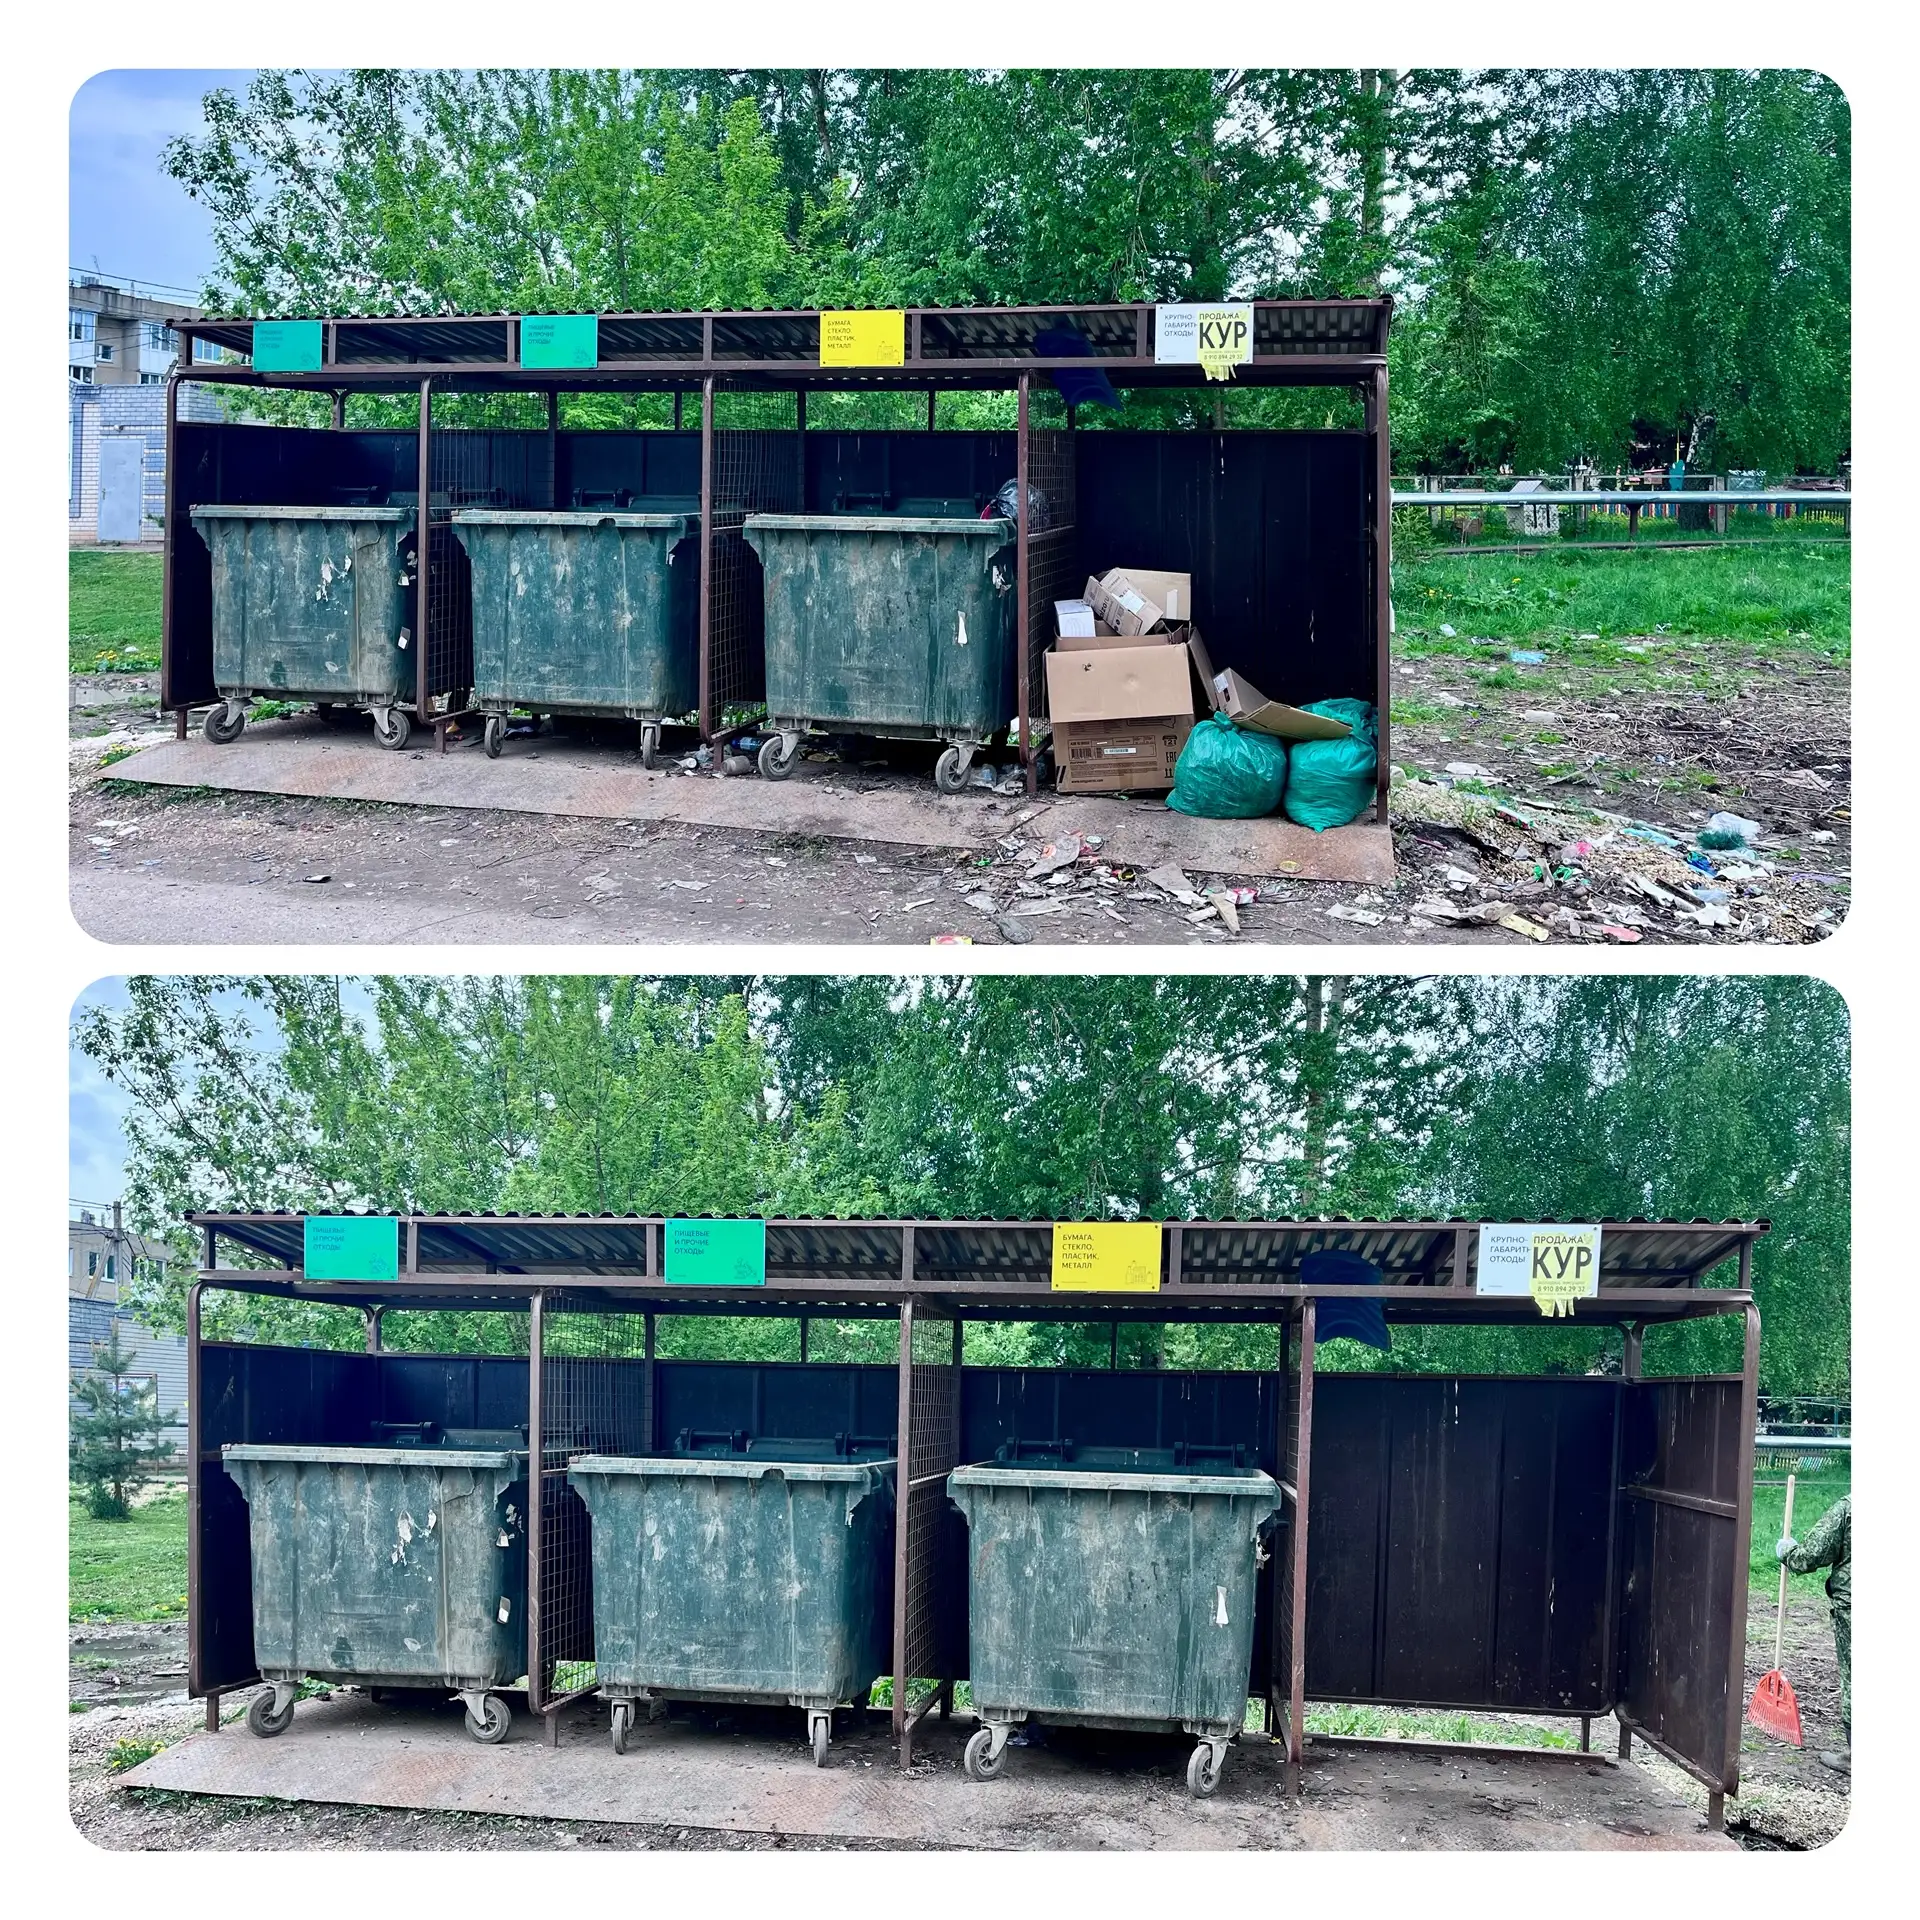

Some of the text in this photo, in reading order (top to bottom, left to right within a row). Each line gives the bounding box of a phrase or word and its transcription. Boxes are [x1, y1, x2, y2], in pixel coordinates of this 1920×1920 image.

[1199, 313, 1239, 321] ПРОДАЖА
[1199, 321, 1247, 349] КУР
[1533, 1235, 1583, 1245] ПРОДАЖА
[1489, 1255, 1525, 1263] ОТХОДЫ
[1532, 1246, 1593, 1279] КУР
